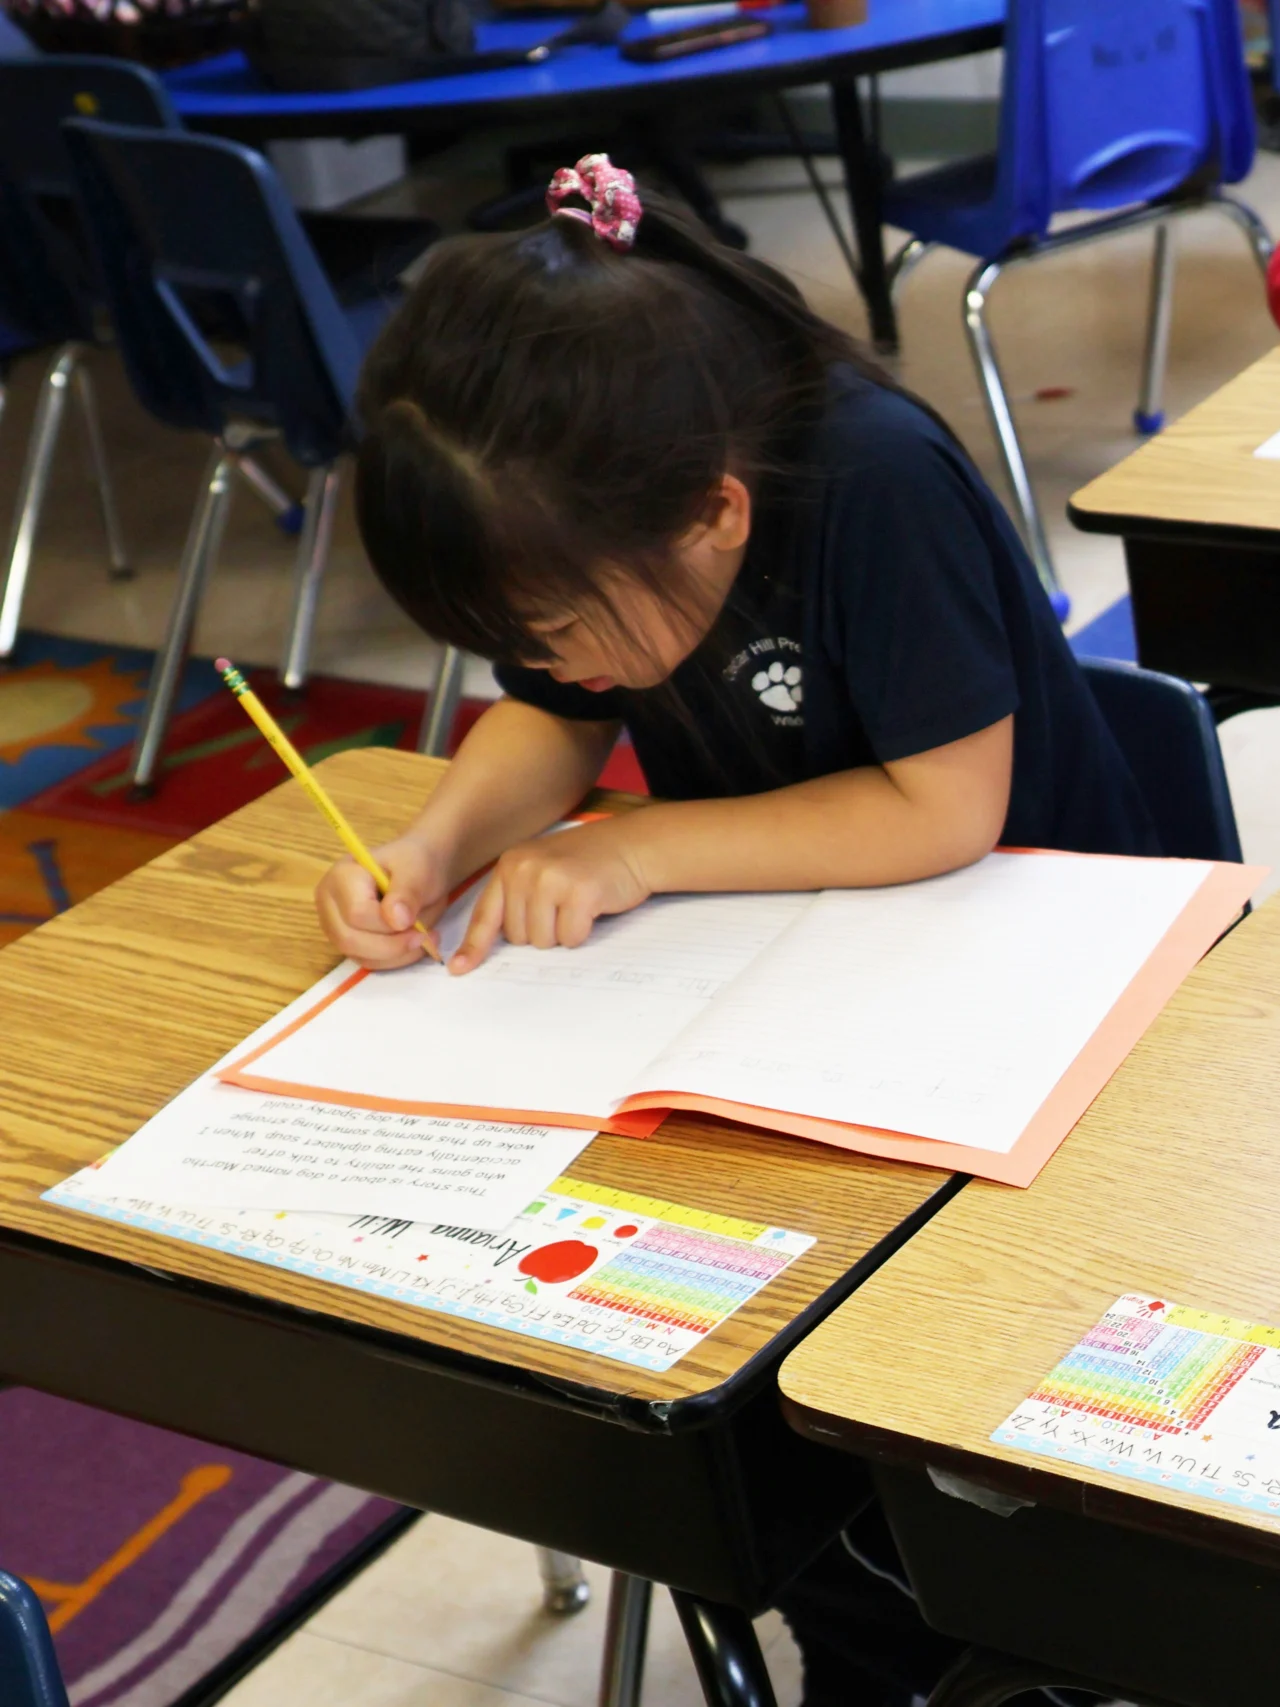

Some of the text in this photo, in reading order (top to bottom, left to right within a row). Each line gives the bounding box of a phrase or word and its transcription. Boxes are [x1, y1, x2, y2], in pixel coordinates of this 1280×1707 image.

[749, 638, 776, 655] Hill
[259, 1099, 302, 1111] could
[306, 1104, 360, 1120] Sparky
[364, 1111, 391, 1122] dog
[394, 1115, 422, 1125] My
[196, 1125, 209, 1135] I
[212, 1126, 255, 1140] When
[229, 1112, 534, 1151] woke up this morning something strange
[455, 1121, 469, 1130] to
[473, 1124, 548, 1138] happened
[302, 1138, 370, 1153] alphabet
[373, 1144, 422, 1156] eating
[181, 1156, 238, 1171] Martha
[241, 1146, 505, 1180] who gains the ability to talk after
[425, 1149, 520, 1165] accidentally
[241, 1163, 291, 1176] named
[295, 1169, 323, 1180] dog
[340, 1175, 386, 1184] about
[389, 1177, 403, 1185] is
[409, 1178, 451, 1191] story
[455, 1185, 486, 1196] This
[429, 1224, 531, 1266] Arianna
[522, 1307, 549, 1320] Ff
[553, 1312, 573, 1326] Ee
[577, 1319, 600, 1334] Dd
[630, 1333, 654, 1349] Bb
[657, 1341, 684, 1355] Aa
[1041, 1405, 1087, 1422] CART
[1008, 1413, 1035, 1430] Zz
[1038, 1415, 1059, 1438] Yy
[1068, 1428, 1095, 1446] Xx
[1099, 1436, 1134, 1456] Ww
[1142, 1447, 1162, 1463] Vv
[1170, 1453, 1196, 1470] Uu
[1199, 1463, 1221, 1479] Tt
[1231, 1469, 1255, 1487] Ss
